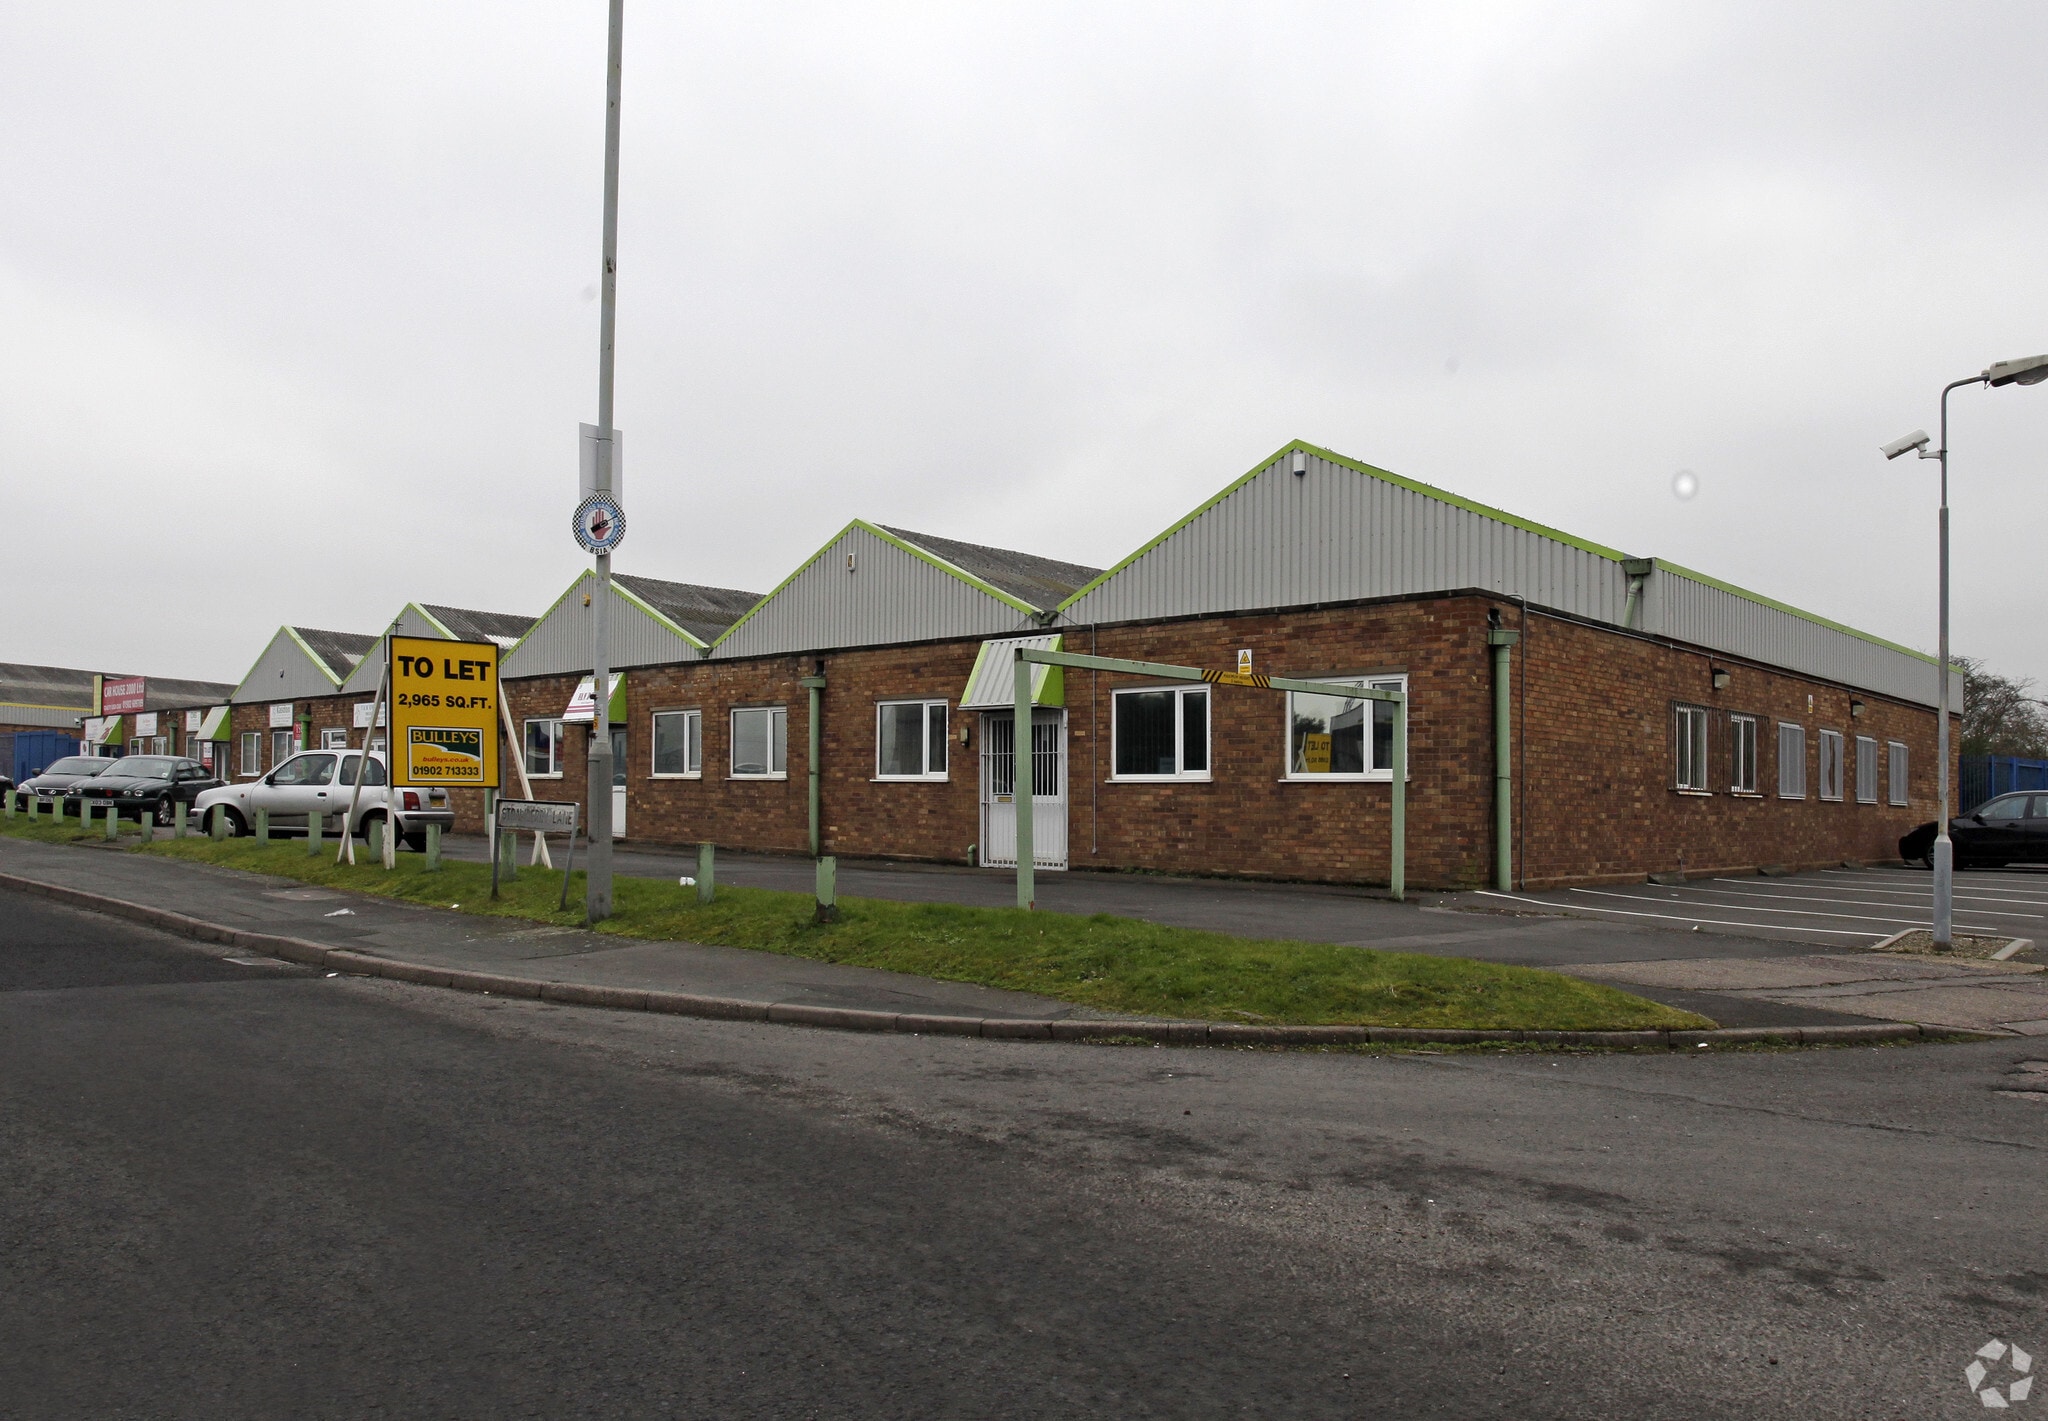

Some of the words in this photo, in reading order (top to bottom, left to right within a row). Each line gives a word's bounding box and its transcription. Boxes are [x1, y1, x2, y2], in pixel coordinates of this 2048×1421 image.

[590, 547, 608, 555] BSIA
[398, 656, 434, 678] TO
[444, 659, 491, 681] LET
[112, 684, 126, 697] HOUSE
[126, 682, 136, 695] 2000
[136, 681, 145, 694] Ltd
[398, 693, 440, 708] 2,965
[446, 695, 492, 709] SQ.FT.
[412, 731, 479, 744] BULLEYS
[413, 766, 442, 775] 01902
[445, 767, 479, 776] 713333
[552, 810, 574, 825] LANE
